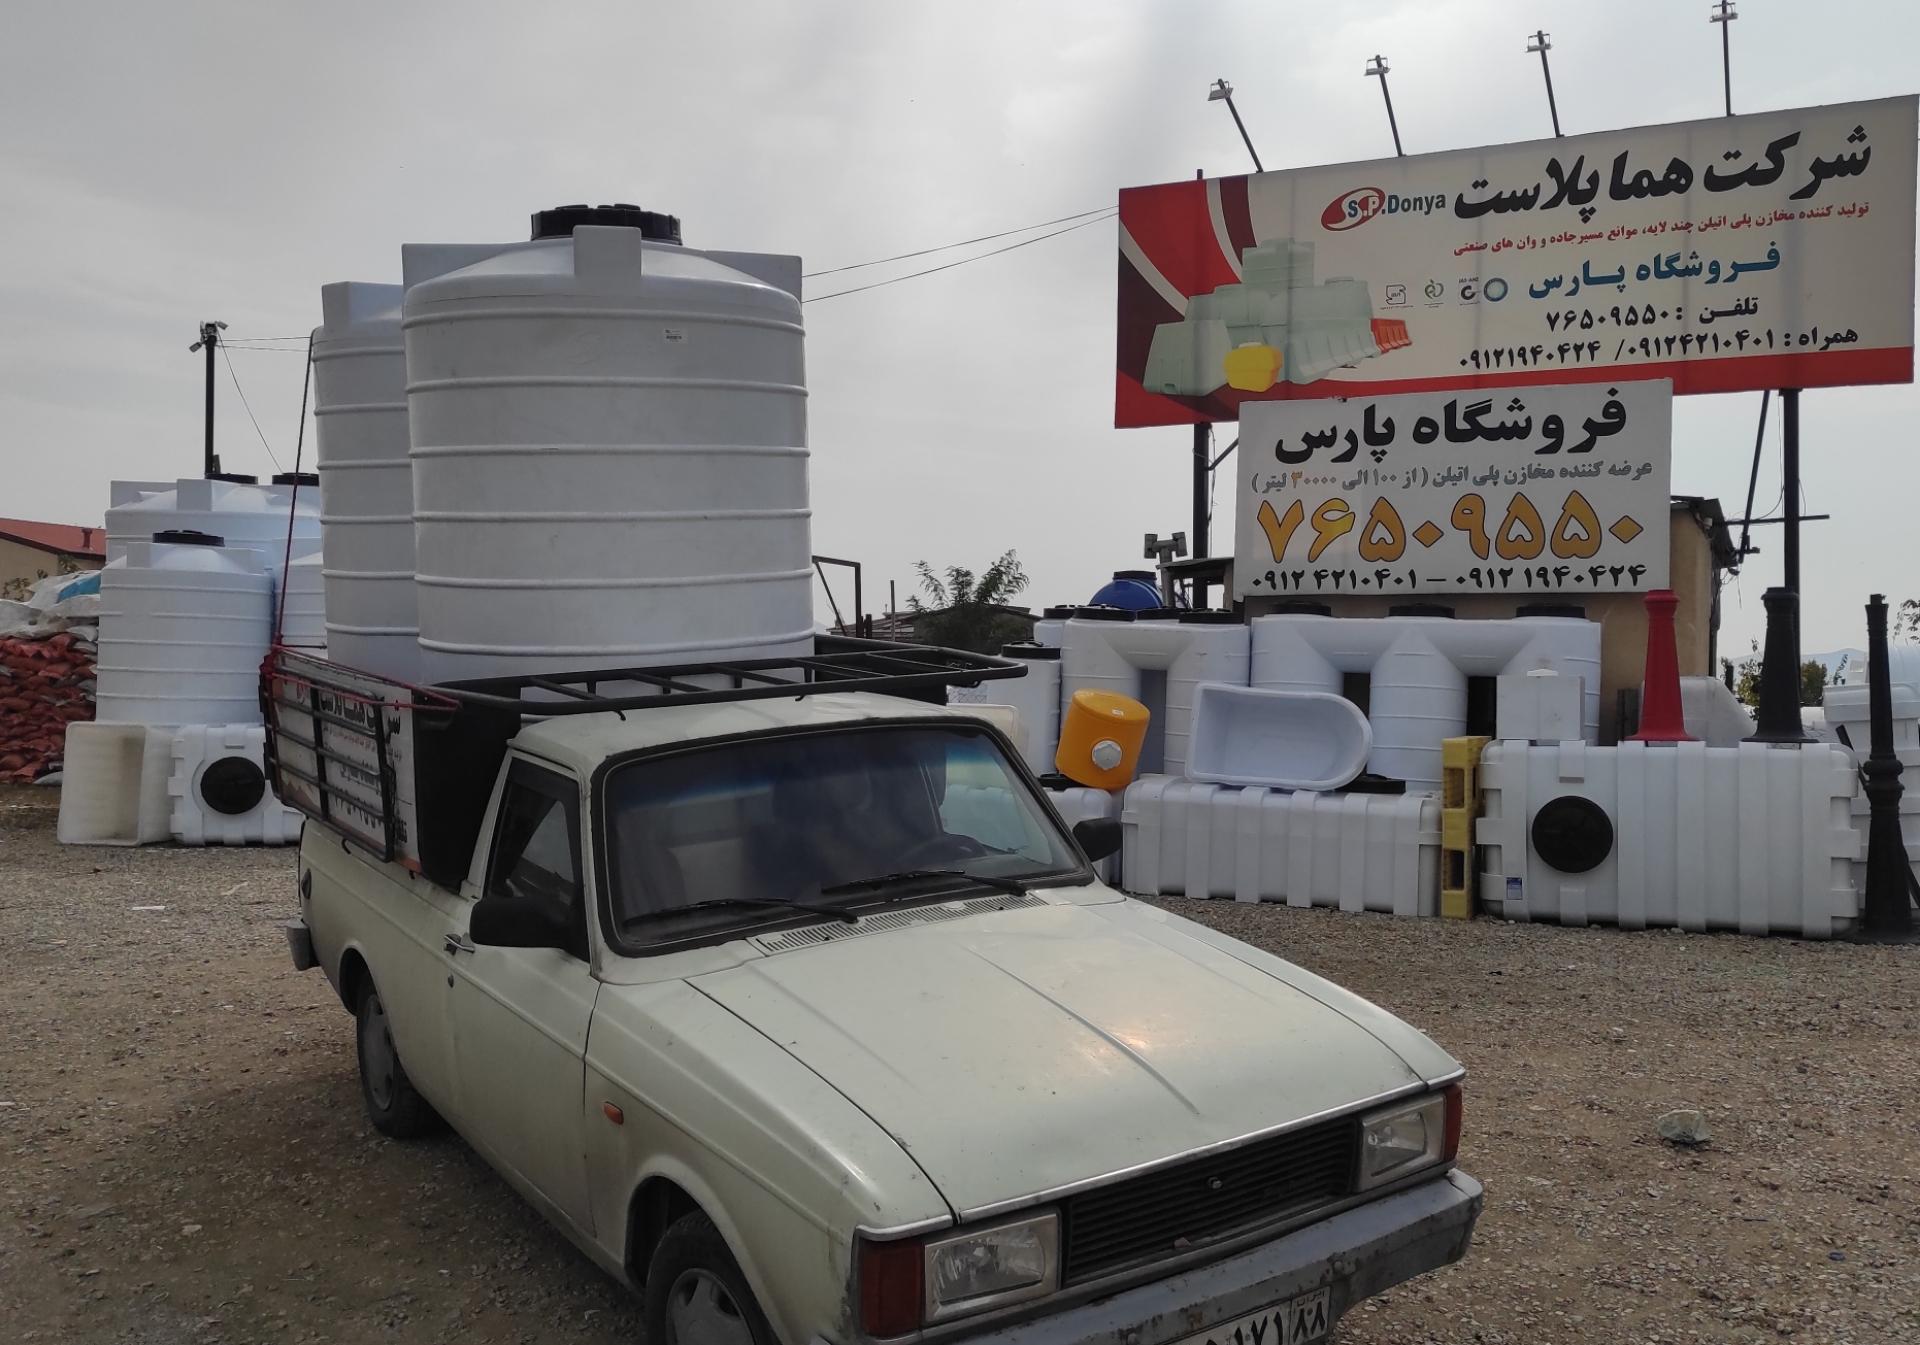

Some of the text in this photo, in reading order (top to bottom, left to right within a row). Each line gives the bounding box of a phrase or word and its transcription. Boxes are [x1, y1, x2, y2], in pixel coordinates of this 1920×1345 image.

[1454, 125, 1871, 224] شرکت هما پلاست
[1755, 209, 1795, 226] مخازن
[1799, 205, 1833, 219] کننده
[1837, 201, 1870, 216] تولید
[1671, 220, 1694, 234] چند
[1697, 215, 1727, 232] اتیلن
[1730, 213, 1752, 229] پلی
[1516, 235, 1537, 249] وان
[1540, 237, 1547, 248] و
[1607, 225, 1638, 240] موانع
[1453, 242, 1488, 256] صنعتی
[1491, 237, 1513, 253] های
[1528, 241, 1781, 298] فروشگاه پارس
[1546, 303, 1669, 332] ۷۶۵۰۹۵۵۰
[1699, 296, 1758, 324] تلفن
[1798, 326, 1858, 351] همراه
[1459, 338, 1601, 370] ۰۹۱۲۱۹۴۰۴۲۴
[1275, 387, 1627, 464] فروشگاه پارس
[1432, 466, 1468, 487] اتیلن
[1472, 465, 1500, 486] پلی
[1504, 463, 1555, 485] مخازن
[1559, 461, 1604, 478] کننده
[1608, 461, 1652, 480] عرضه
[1342, 469, 1368, 491] الی
[1257, 489, 1643, 564] ۷۶۵۰۹۵۵۰
[1252, 569, 1305, 590] ۰۹۱۲
[1313, 568, 1417, 589] ۴۲۱۰۴۰۱
[1455, 566, 1513, 589] ۰۹۱۲
[1523, 564, 1648, 588] ۱۹۴۰۴۲۴
